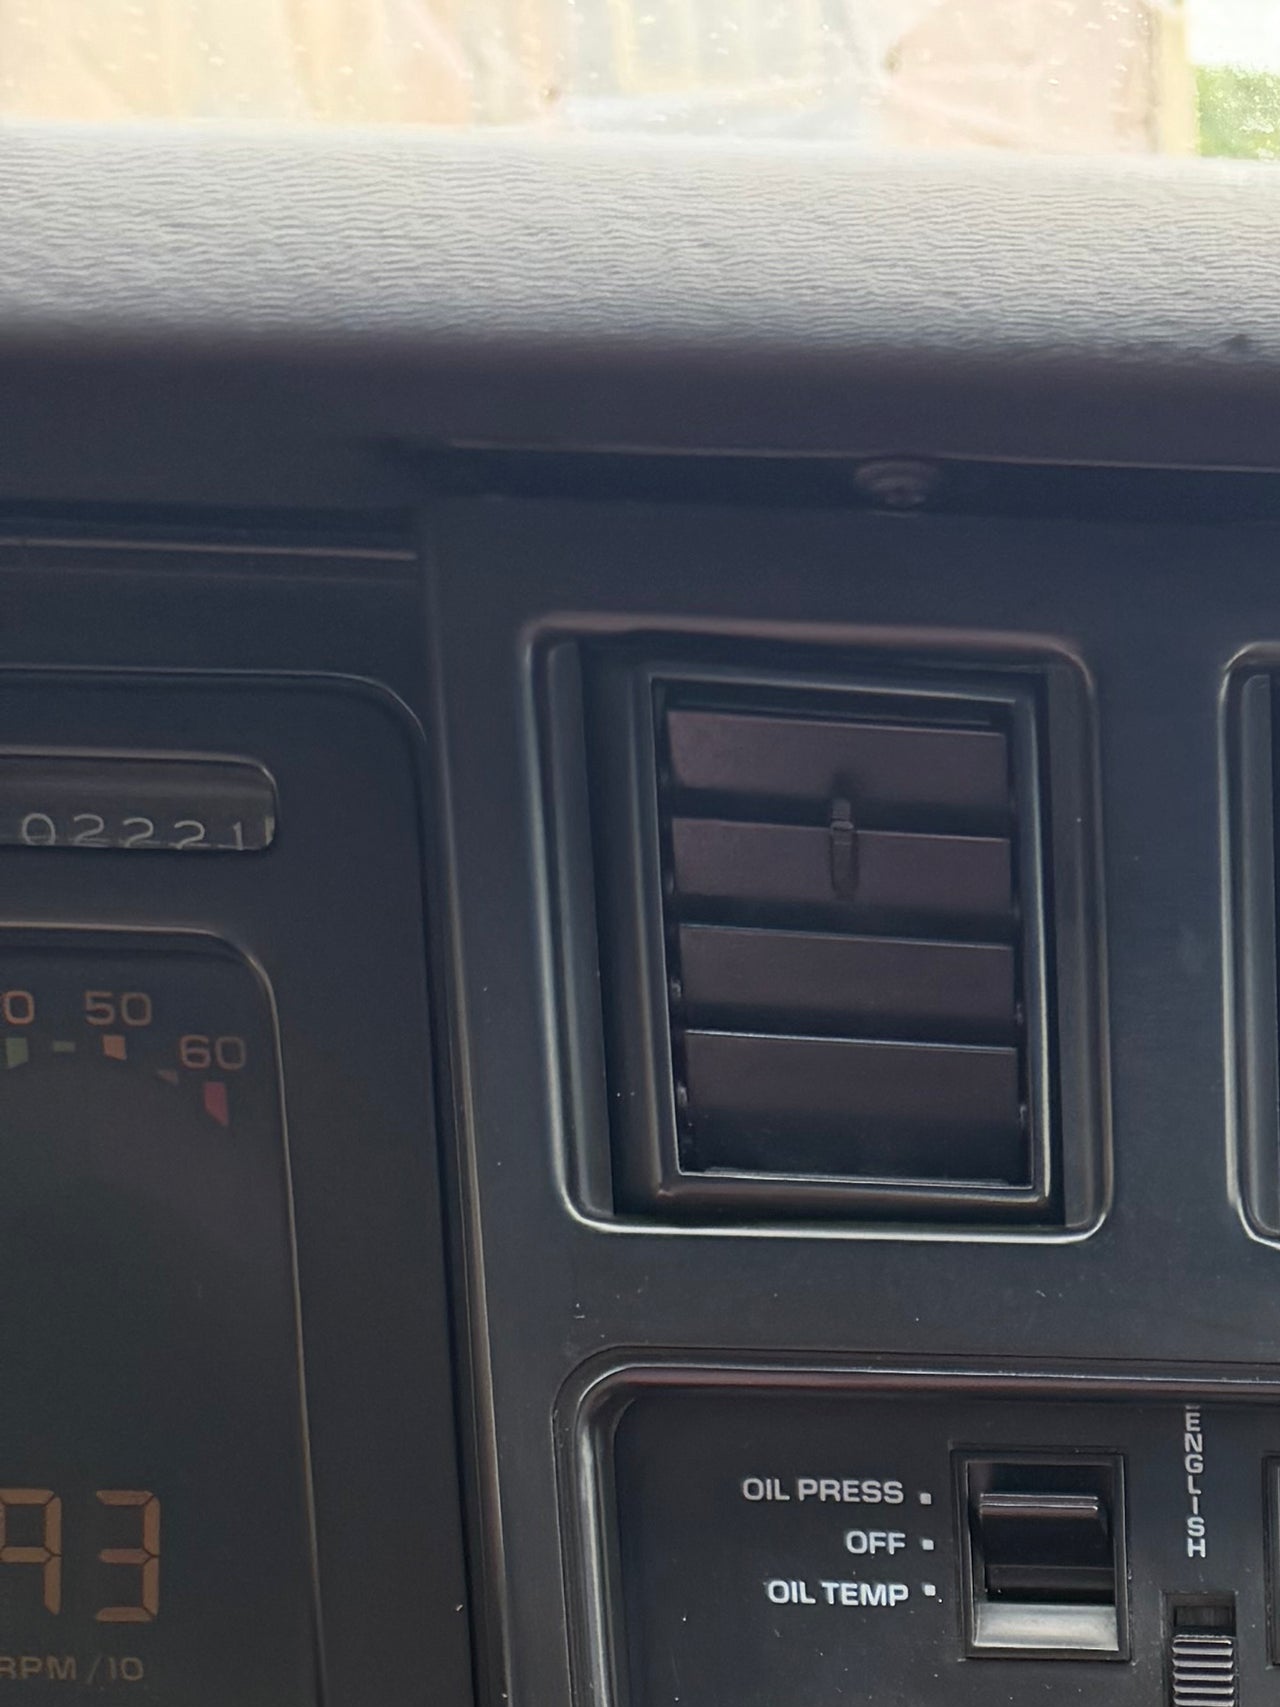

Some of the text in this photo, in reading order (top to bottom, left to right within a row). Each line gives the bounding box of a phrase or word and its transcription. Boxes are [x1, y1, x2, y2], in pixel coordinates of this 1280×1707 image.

[84, 991, 153, 1026] 50
[179, 1035, 246, 1070] 60
[742, 1479, 904, 1503] OIL PRESS
[1184, 1411, 1207, 1558] ENGLISH
[846, 1531, 906, 1555] OFF
[767, 1580, 908, 1606] OIL TEMP
